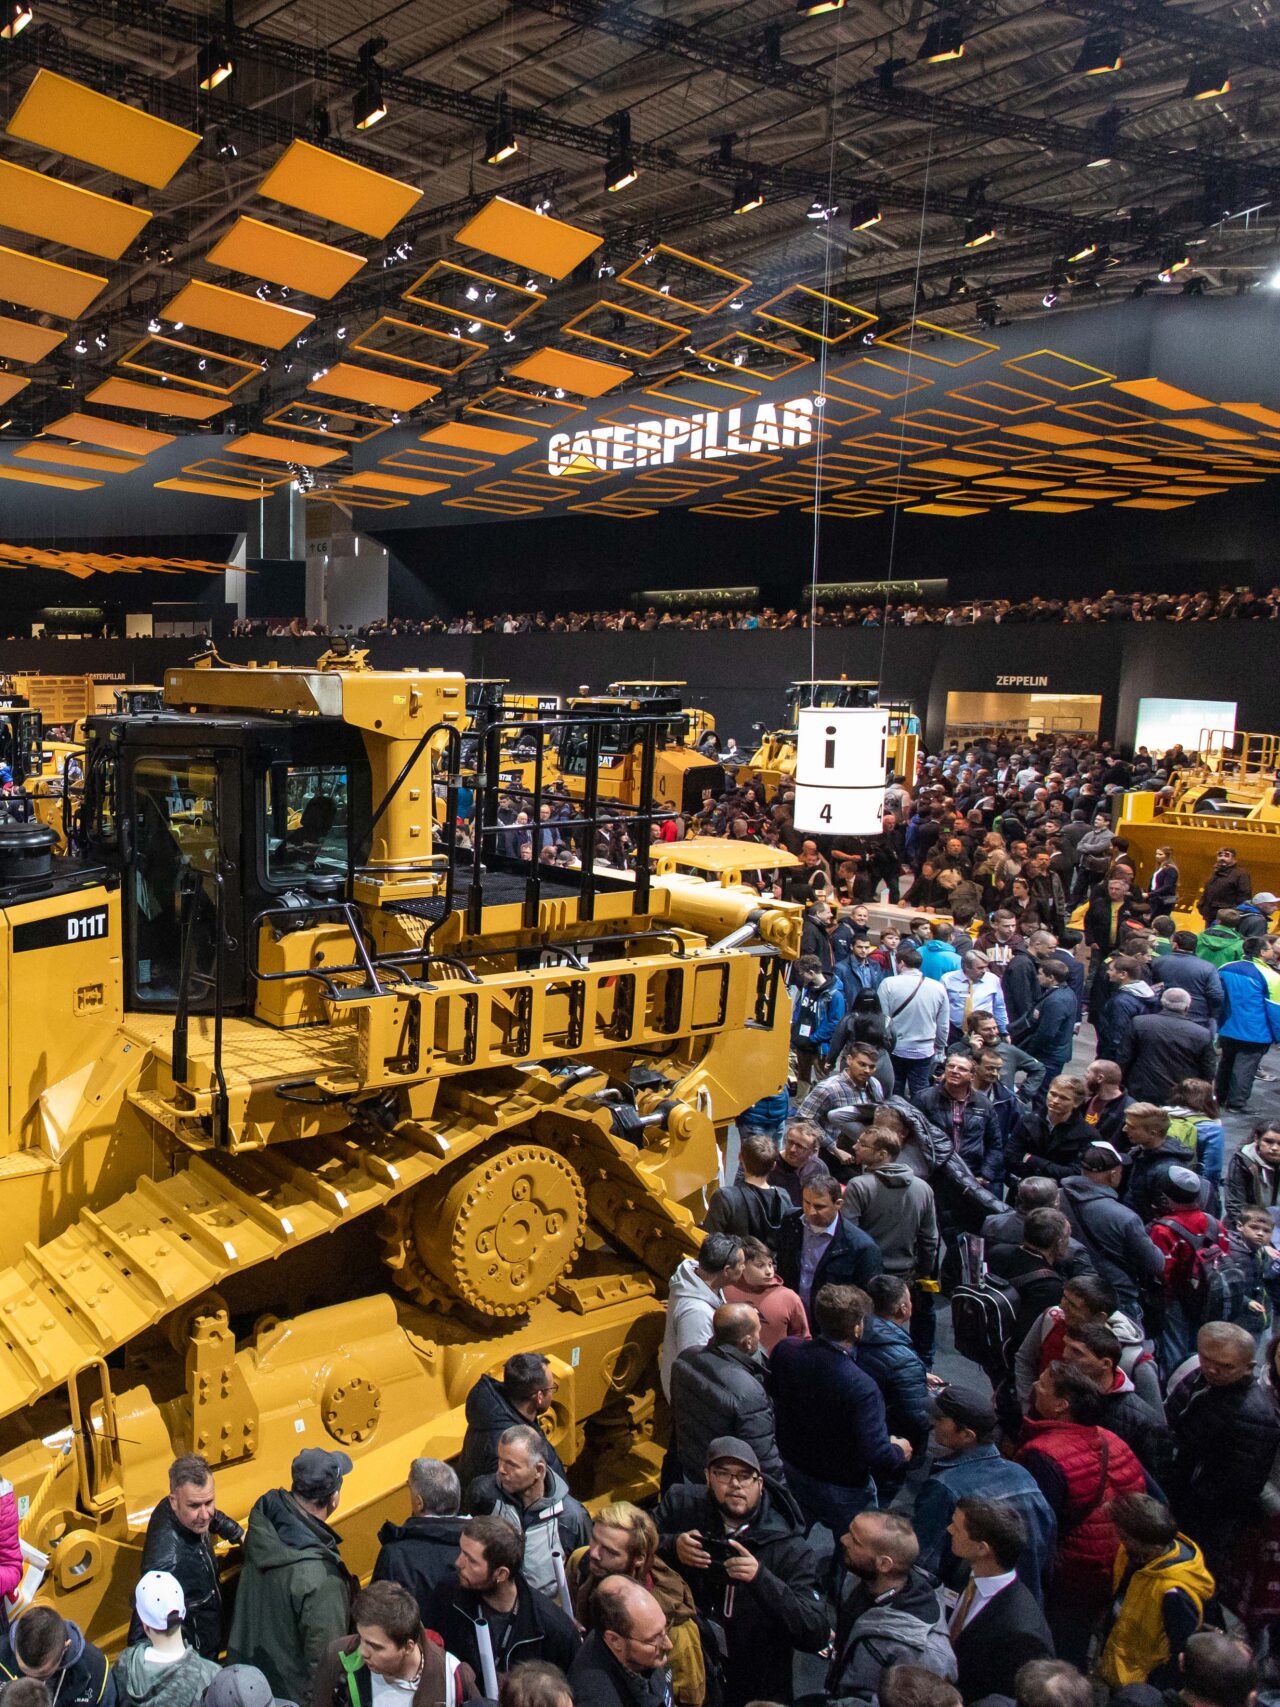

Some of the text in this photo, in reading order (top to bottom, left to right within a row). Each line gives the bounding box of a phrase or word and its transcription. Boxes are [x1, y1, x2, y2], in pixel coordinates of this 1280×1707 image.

[316, 543, 327, 552] C6
[996, 676, 1048, 686] ZEPPELIN
[539, 702, 556, 710] CAT
[824, 725, 837, 769] i
[598, 755, 614, 768] CAT
[819, 803, 833, 824] 4
[67, 913, 106, 940] D11T
